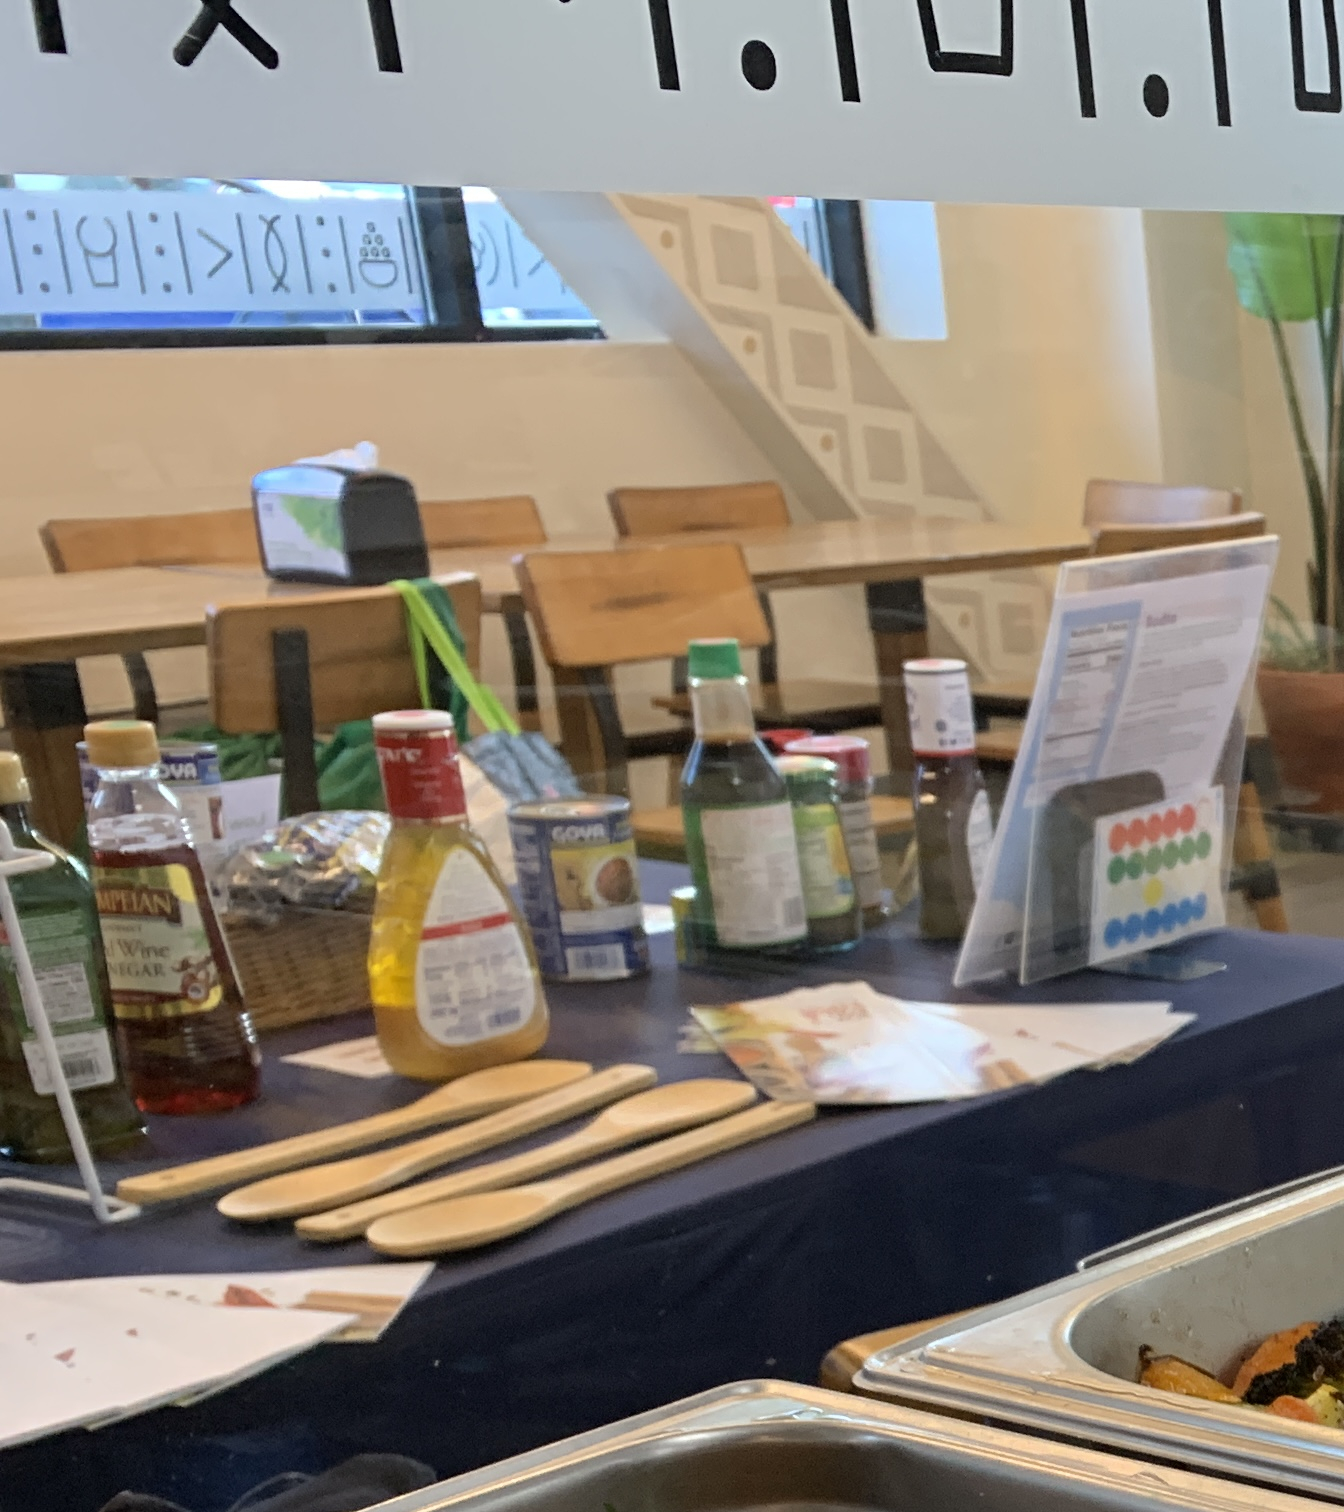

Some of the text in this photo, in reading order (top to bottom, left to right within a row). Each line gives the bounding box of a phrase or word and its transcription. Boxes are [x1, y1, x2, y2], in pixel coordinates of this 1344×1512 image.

[551, 823, 605, 842] GOYA
[97, 888, 173, 915] MPEIAN
[117, 938, 171, 959] Wine
[110, 962, 165, 978] NEGAR
